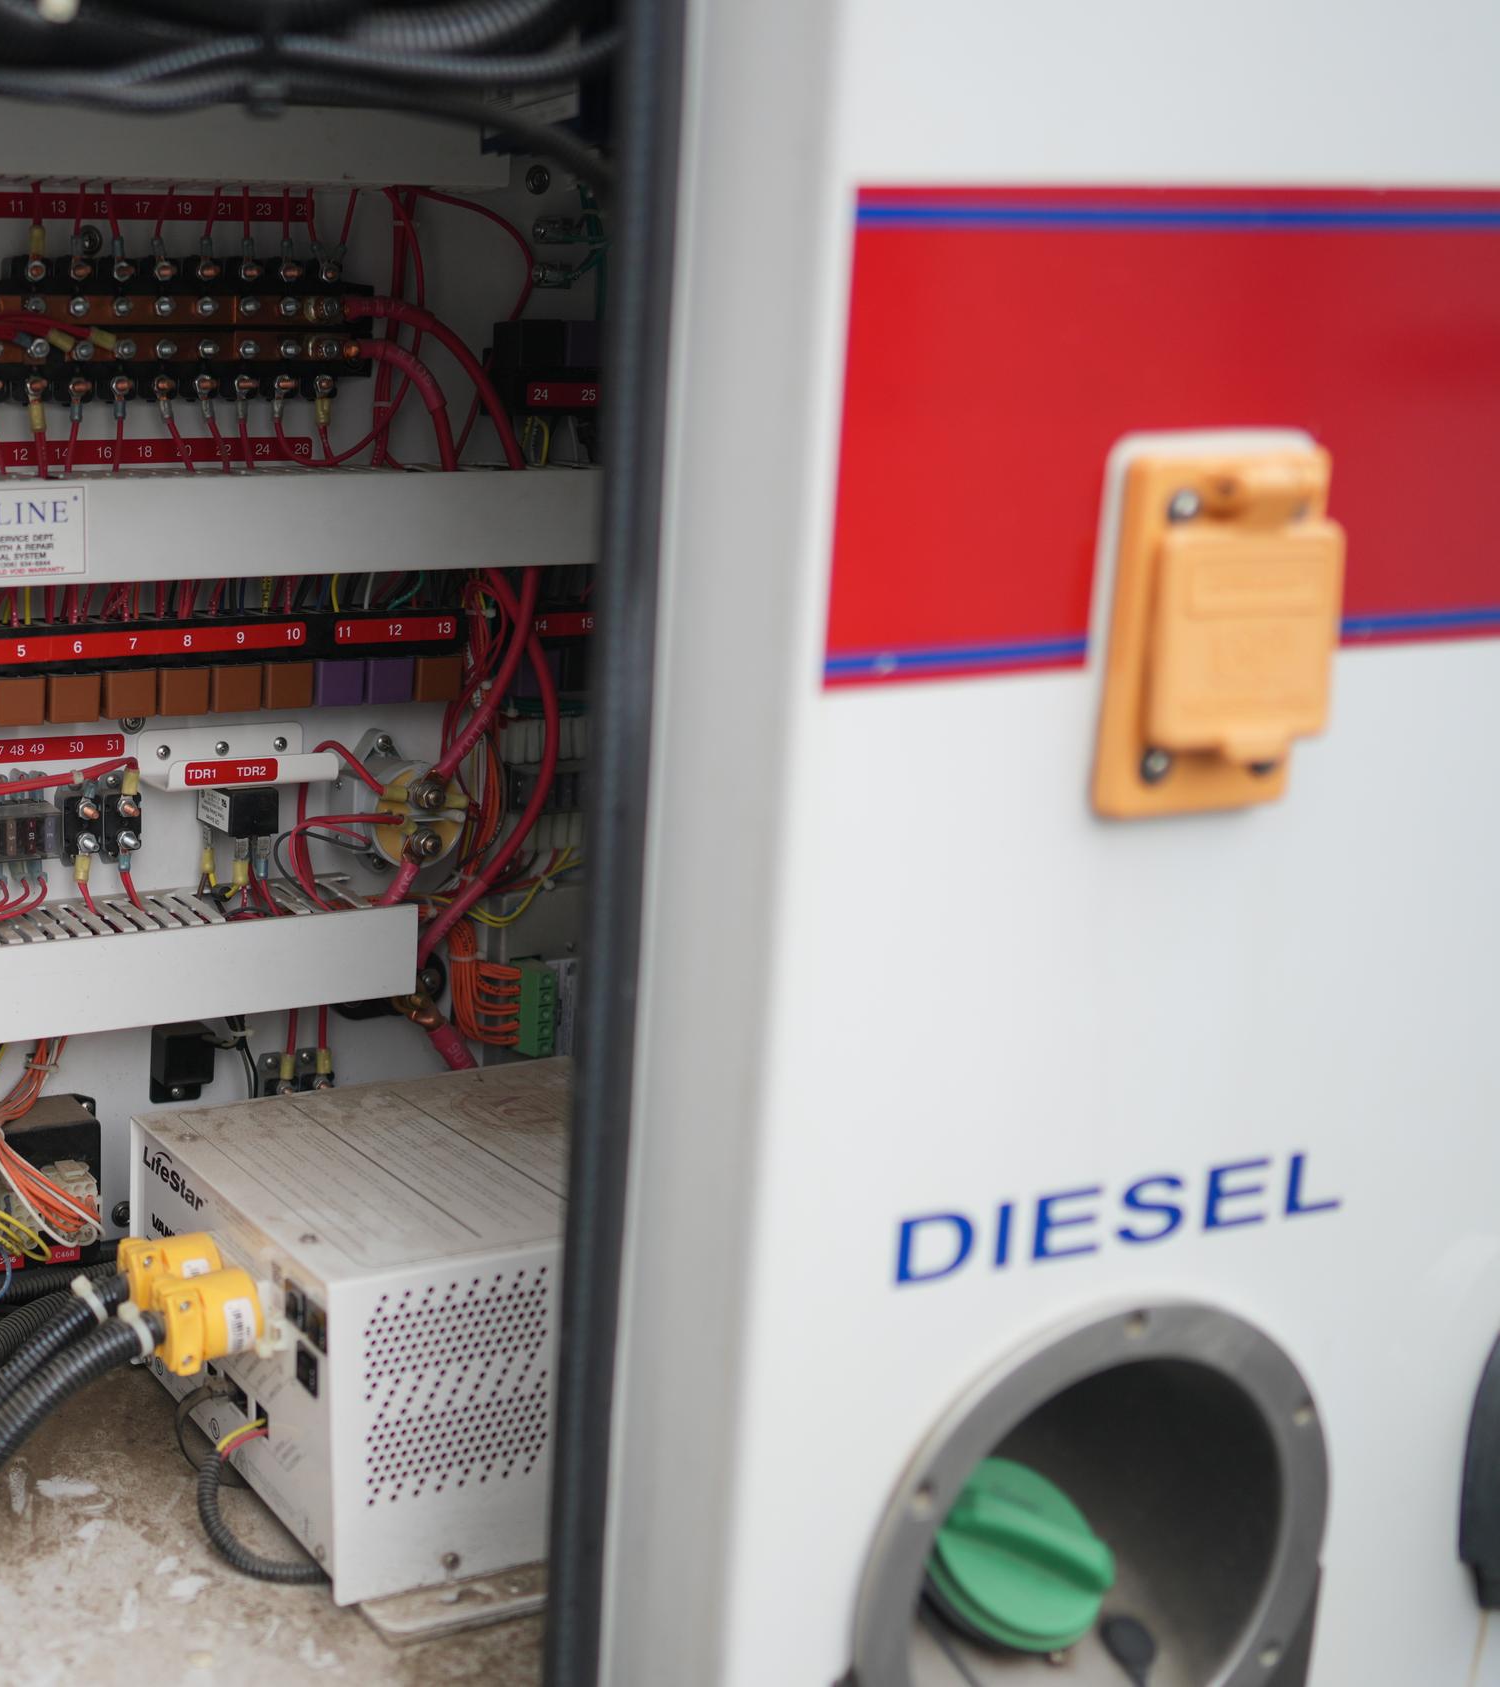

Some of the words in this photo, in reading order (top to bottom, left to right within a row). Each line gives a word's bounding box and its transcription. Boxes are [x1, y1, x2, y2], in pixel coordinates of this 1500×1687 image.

[9, 199, 23, 212] 11
[51, 199, 66, 213] 13
[93, 200, 108, 213] 15
[135, 200, 150, 213] 17
[177, 201, 191, 214] 19
[217, 201, 231, 214] 21
[255, 202, 271, 215] 23
[533, 388, 548, 400] 24
[581, 388, 595, 400] 25
[12, 448, 28, 460] 12
[96, 446, 111, 458] 16
[137, 445, 152, 457] 18
[255, 443, 269, 455] 24
[294, 442, 309, 454] 26
[16, 543, 22, 551] A
[25, 542, 54, 551] REPAIR
[14, 551, 46, 561] SYSTEM
[10, 567, 26, 575] VOID
[28, 565, 65, 574] WARRANTY
[534, 619, 547, 631] 14
[581, 616, 594, 628] 15
[17, 644, 25, 657] 5
[73, 640, 82, 653] 6
[128, 637, 137, 649] 7
[183, 634, 191, 646] 8
[236, 631, 244, 643] 9
[286, 627, 300, 640] 10
[338, 625, 350, 637] 11
[388, 623, 402, 635] 12
[437, 621, 450, 633] 13
[9, 744, 24, 755] 48
[29, 743, 44, 754] 49
[69, 741, 83, 752] 50
[106, 739, 118, 750] 51
[187, 768, 217, 781] TDR1
[236, 765, 267, 777] TDR2
[143, 1145, 204, 1212] LifeStar
[152, 1213, 176, 1238] VAN
[894, 1151, 1343, 1286] DIESEL
